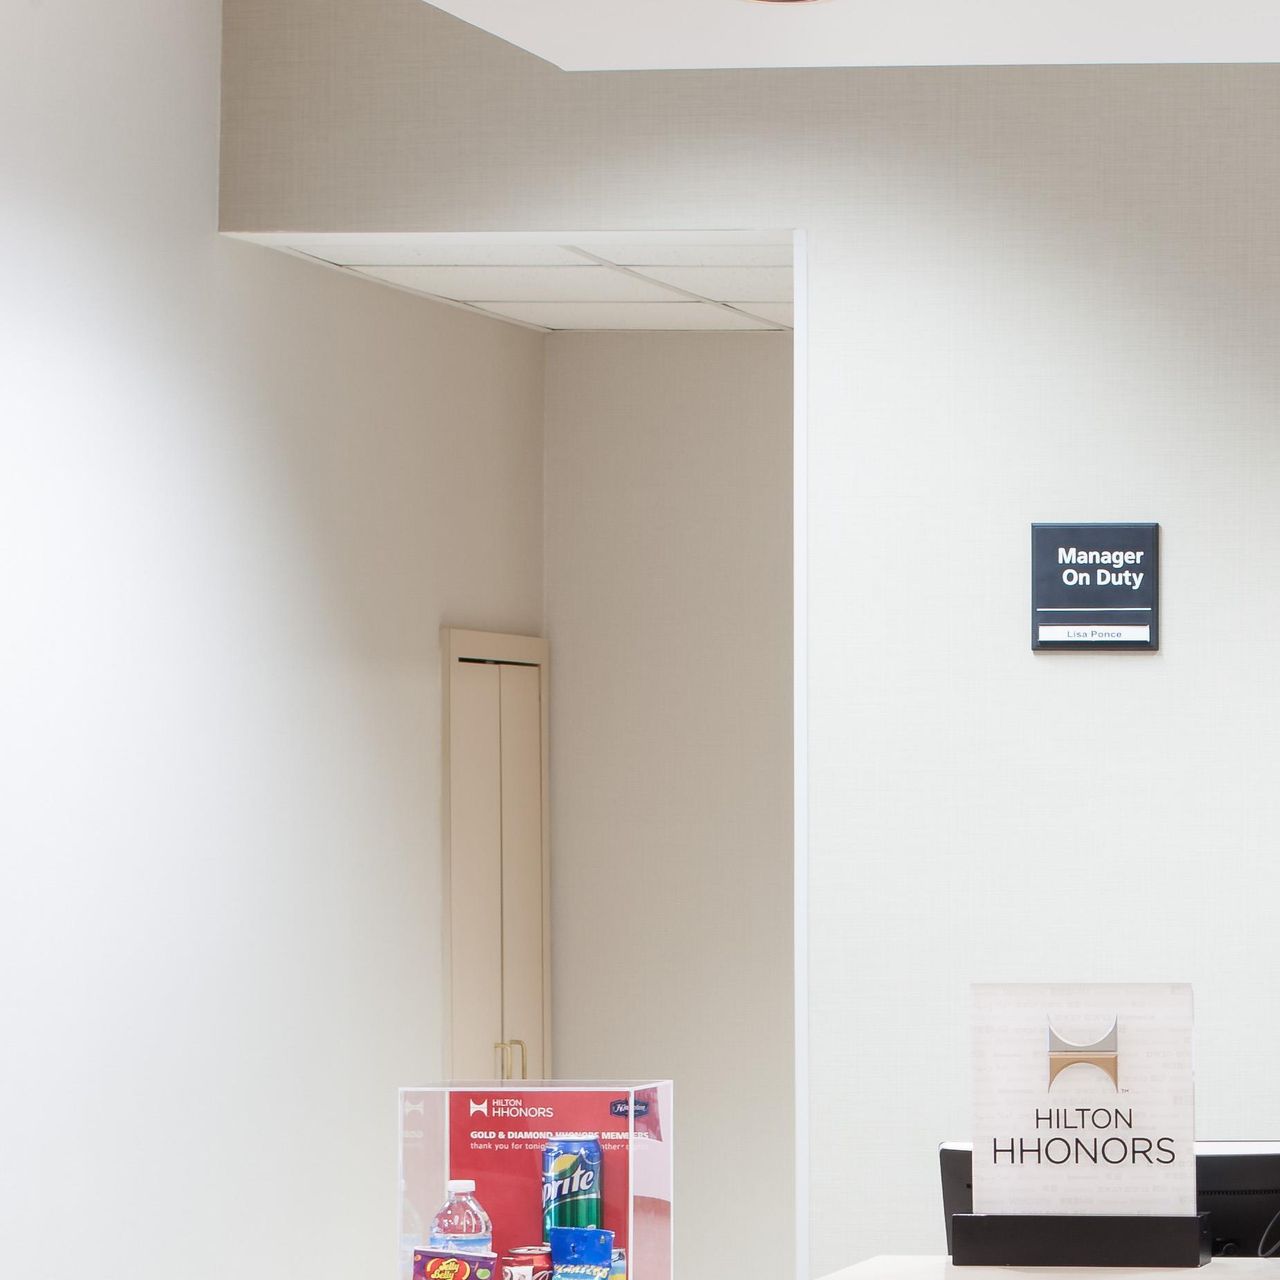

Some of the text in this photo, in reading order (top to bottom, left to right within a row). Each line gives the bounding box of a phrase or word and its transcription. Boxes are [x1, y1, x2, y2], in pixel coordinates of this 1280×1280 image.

[1058, 547, 1144, 568] Manager
[1062, 569, 1144, 590] On Duty
[1067, 630, 1122, 638] Lisa Ponce
[492, 1107, 554, 1118] HHONORS
[1036, 1108, 1133, 1129] HILTON
[470, 1131, 496, 1139] GOLD
[498, 1131, 506, 1139] &
[507, 1131, 553, 1139] DIAMOND
[470, 1142, 492, 1150] thank
[511, 1142, 523, 1150] for
[993, 1137, 1176, 1165] HHONORS
[541, 1164, 594, 1209] prite
